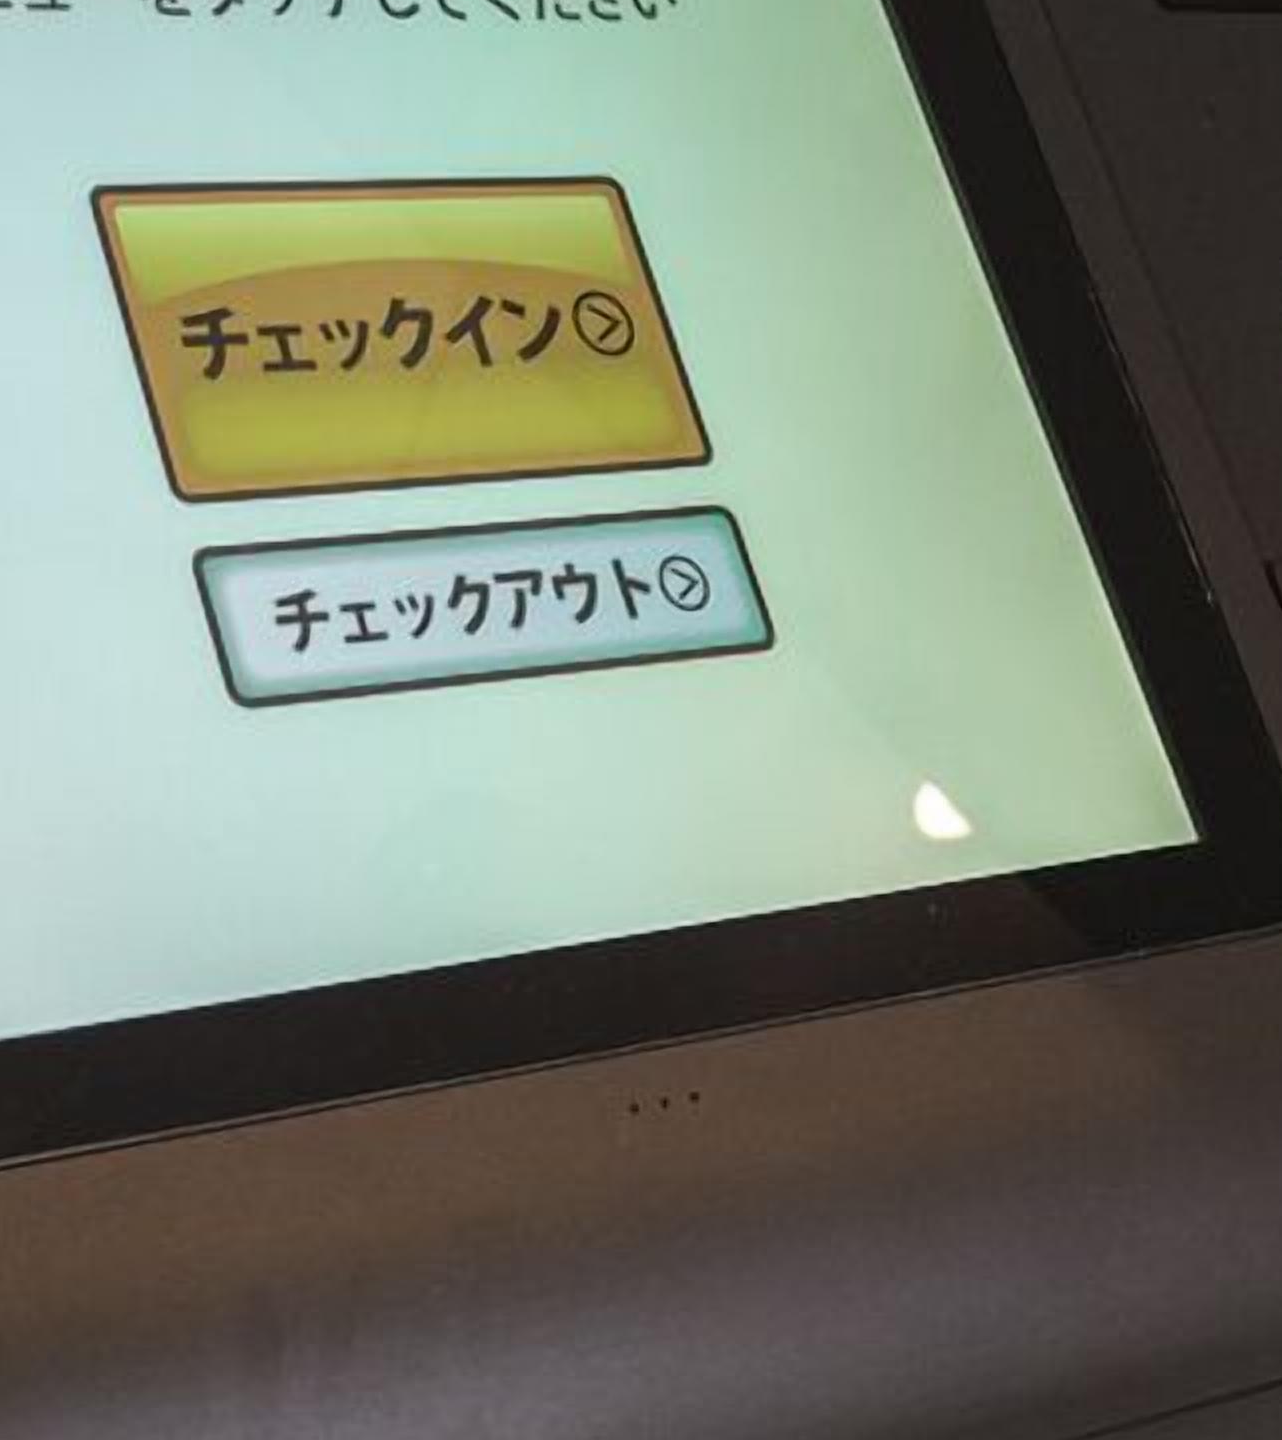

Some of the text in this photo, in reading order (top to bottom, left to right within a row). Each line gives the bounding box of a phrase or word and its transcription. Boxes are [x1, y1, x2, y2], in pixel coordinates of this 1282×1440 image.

[180, 294, 561, 380] チェックイン
[273, 557, 653, 654] チェックアウト
